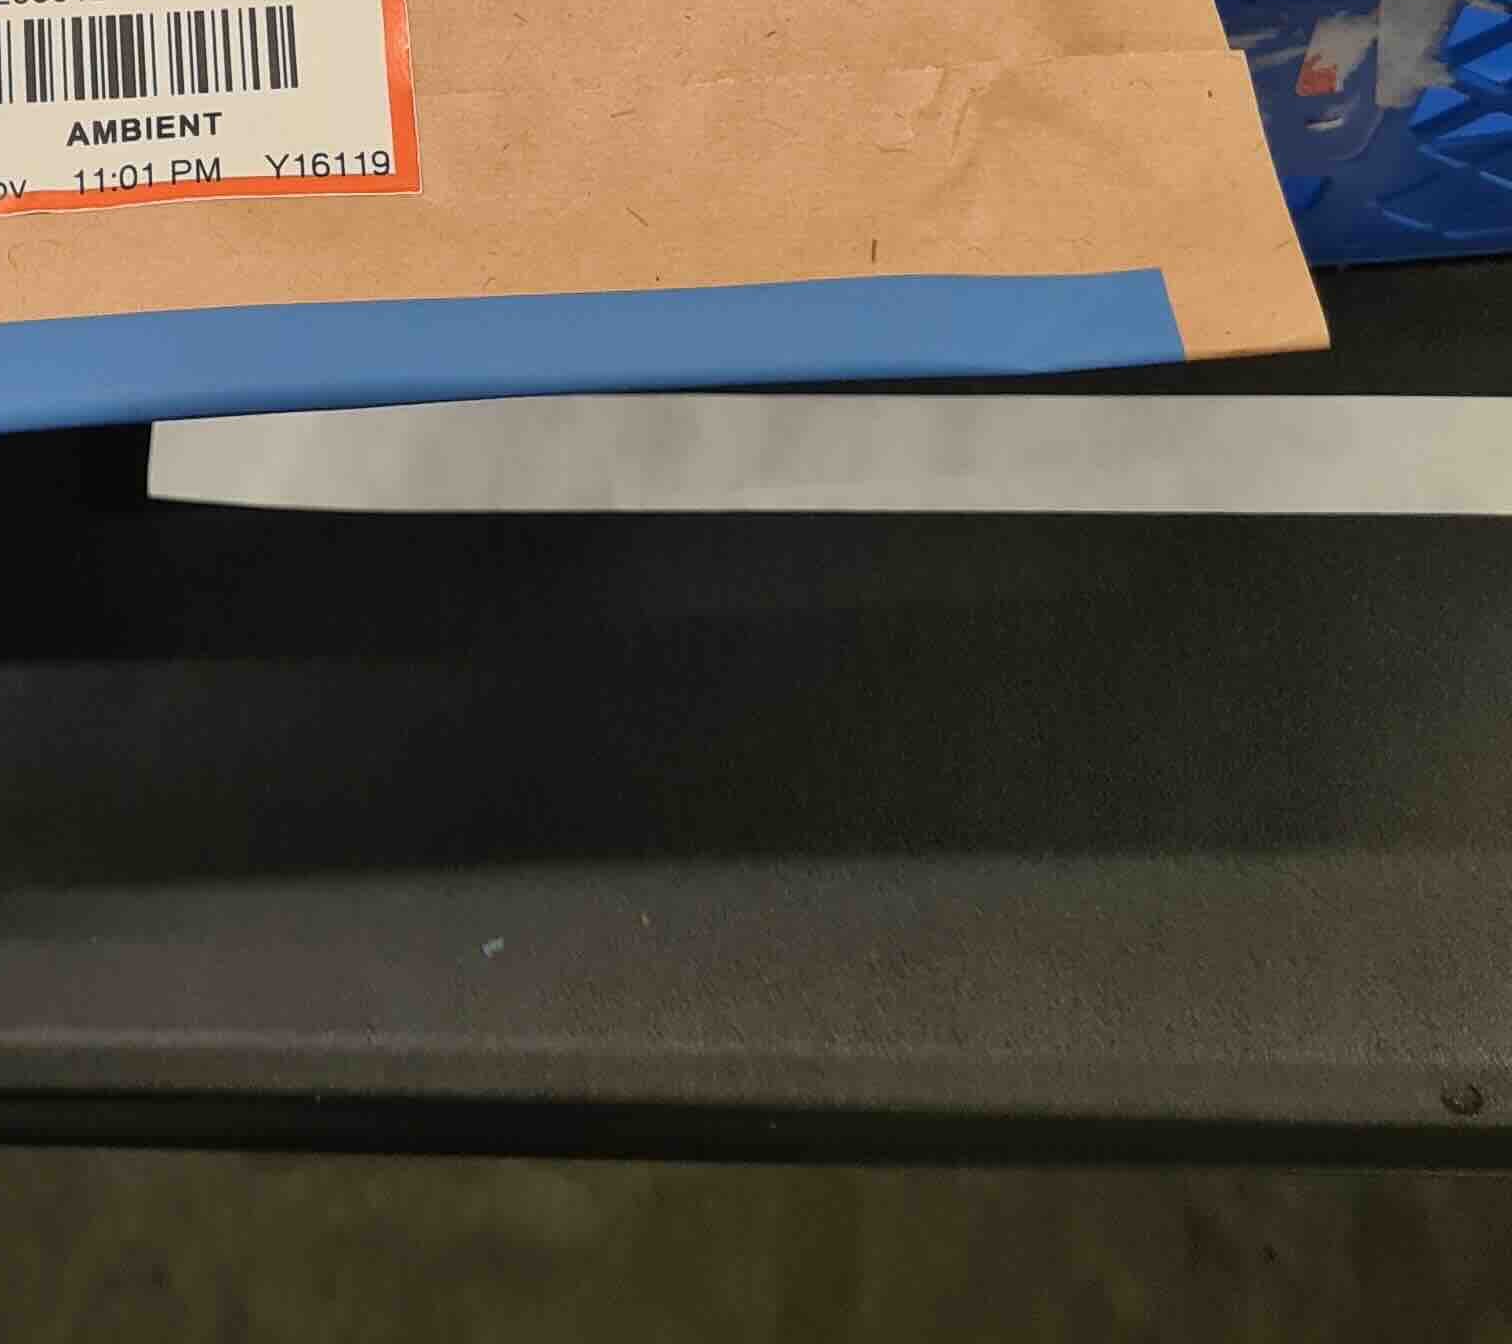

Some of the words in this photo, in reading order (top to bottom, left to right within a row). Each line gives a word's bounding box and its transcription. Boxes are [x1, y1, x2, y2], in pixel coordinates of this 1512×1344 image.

[66, 112, 224, 148] AMBIENT
[72, 162, 155, 195] 11:01
[170, 157, 223, 186] PM
[264, 149, 391, 179] Y16119
